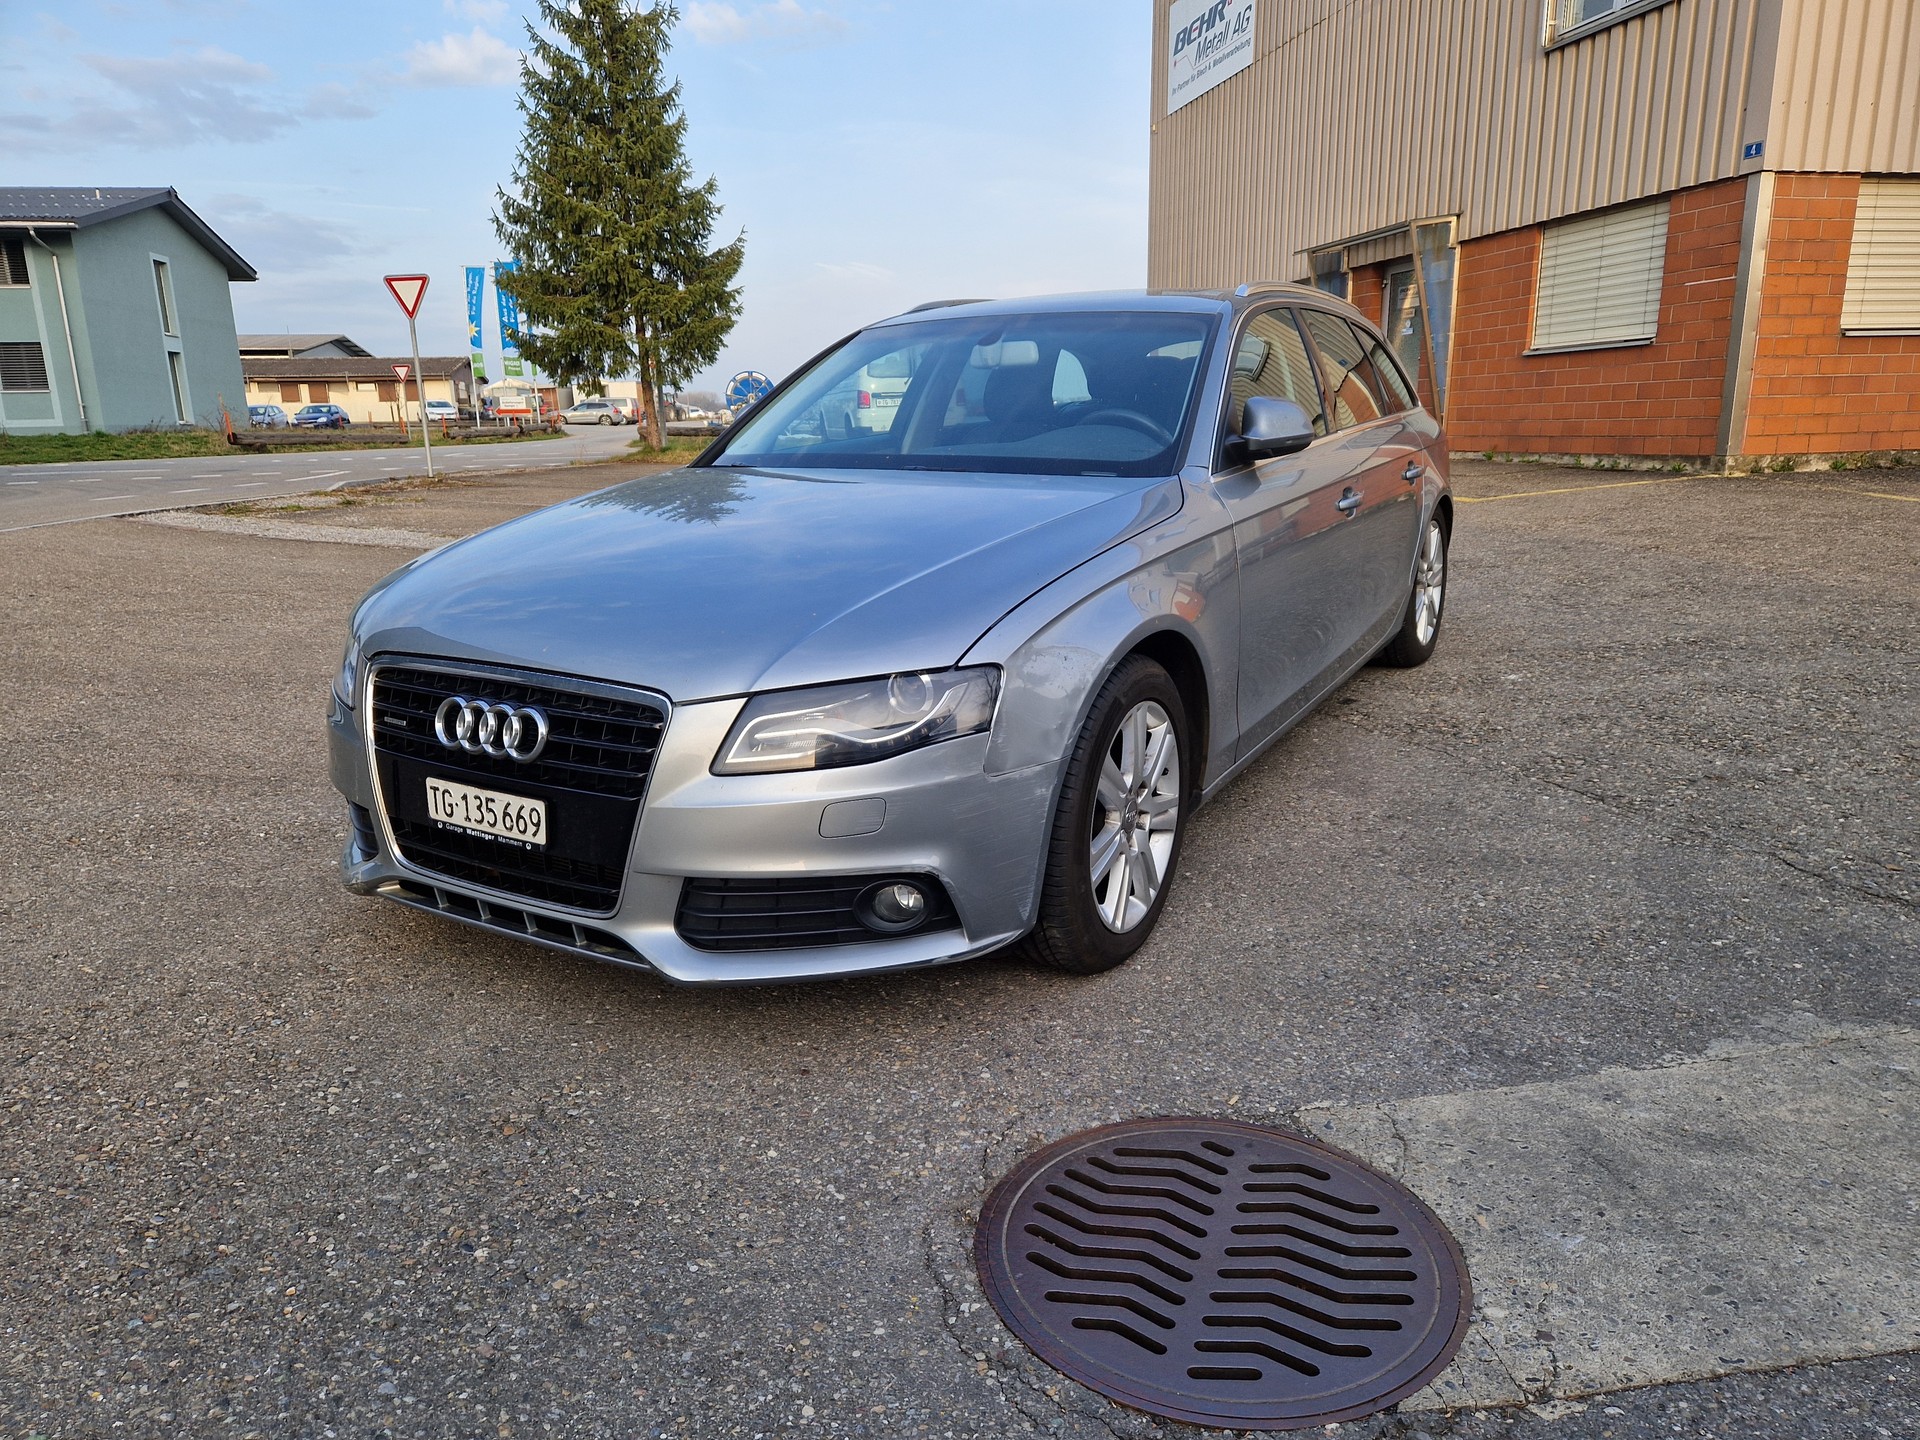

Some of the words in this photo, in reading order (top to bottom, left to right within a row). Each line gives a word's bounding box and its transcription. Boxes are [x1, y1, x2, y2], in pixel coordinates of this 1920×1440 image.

[1173, 0, 1228, 57] BEHR
[1195, 19, 1231, 65] Metall
[1231, 4, 1252, 40] AG
[1750, 144, 1756, 155] 4
[445, 823, 464, 834] Garage
[465, 828, 495, 841] Wattinger
